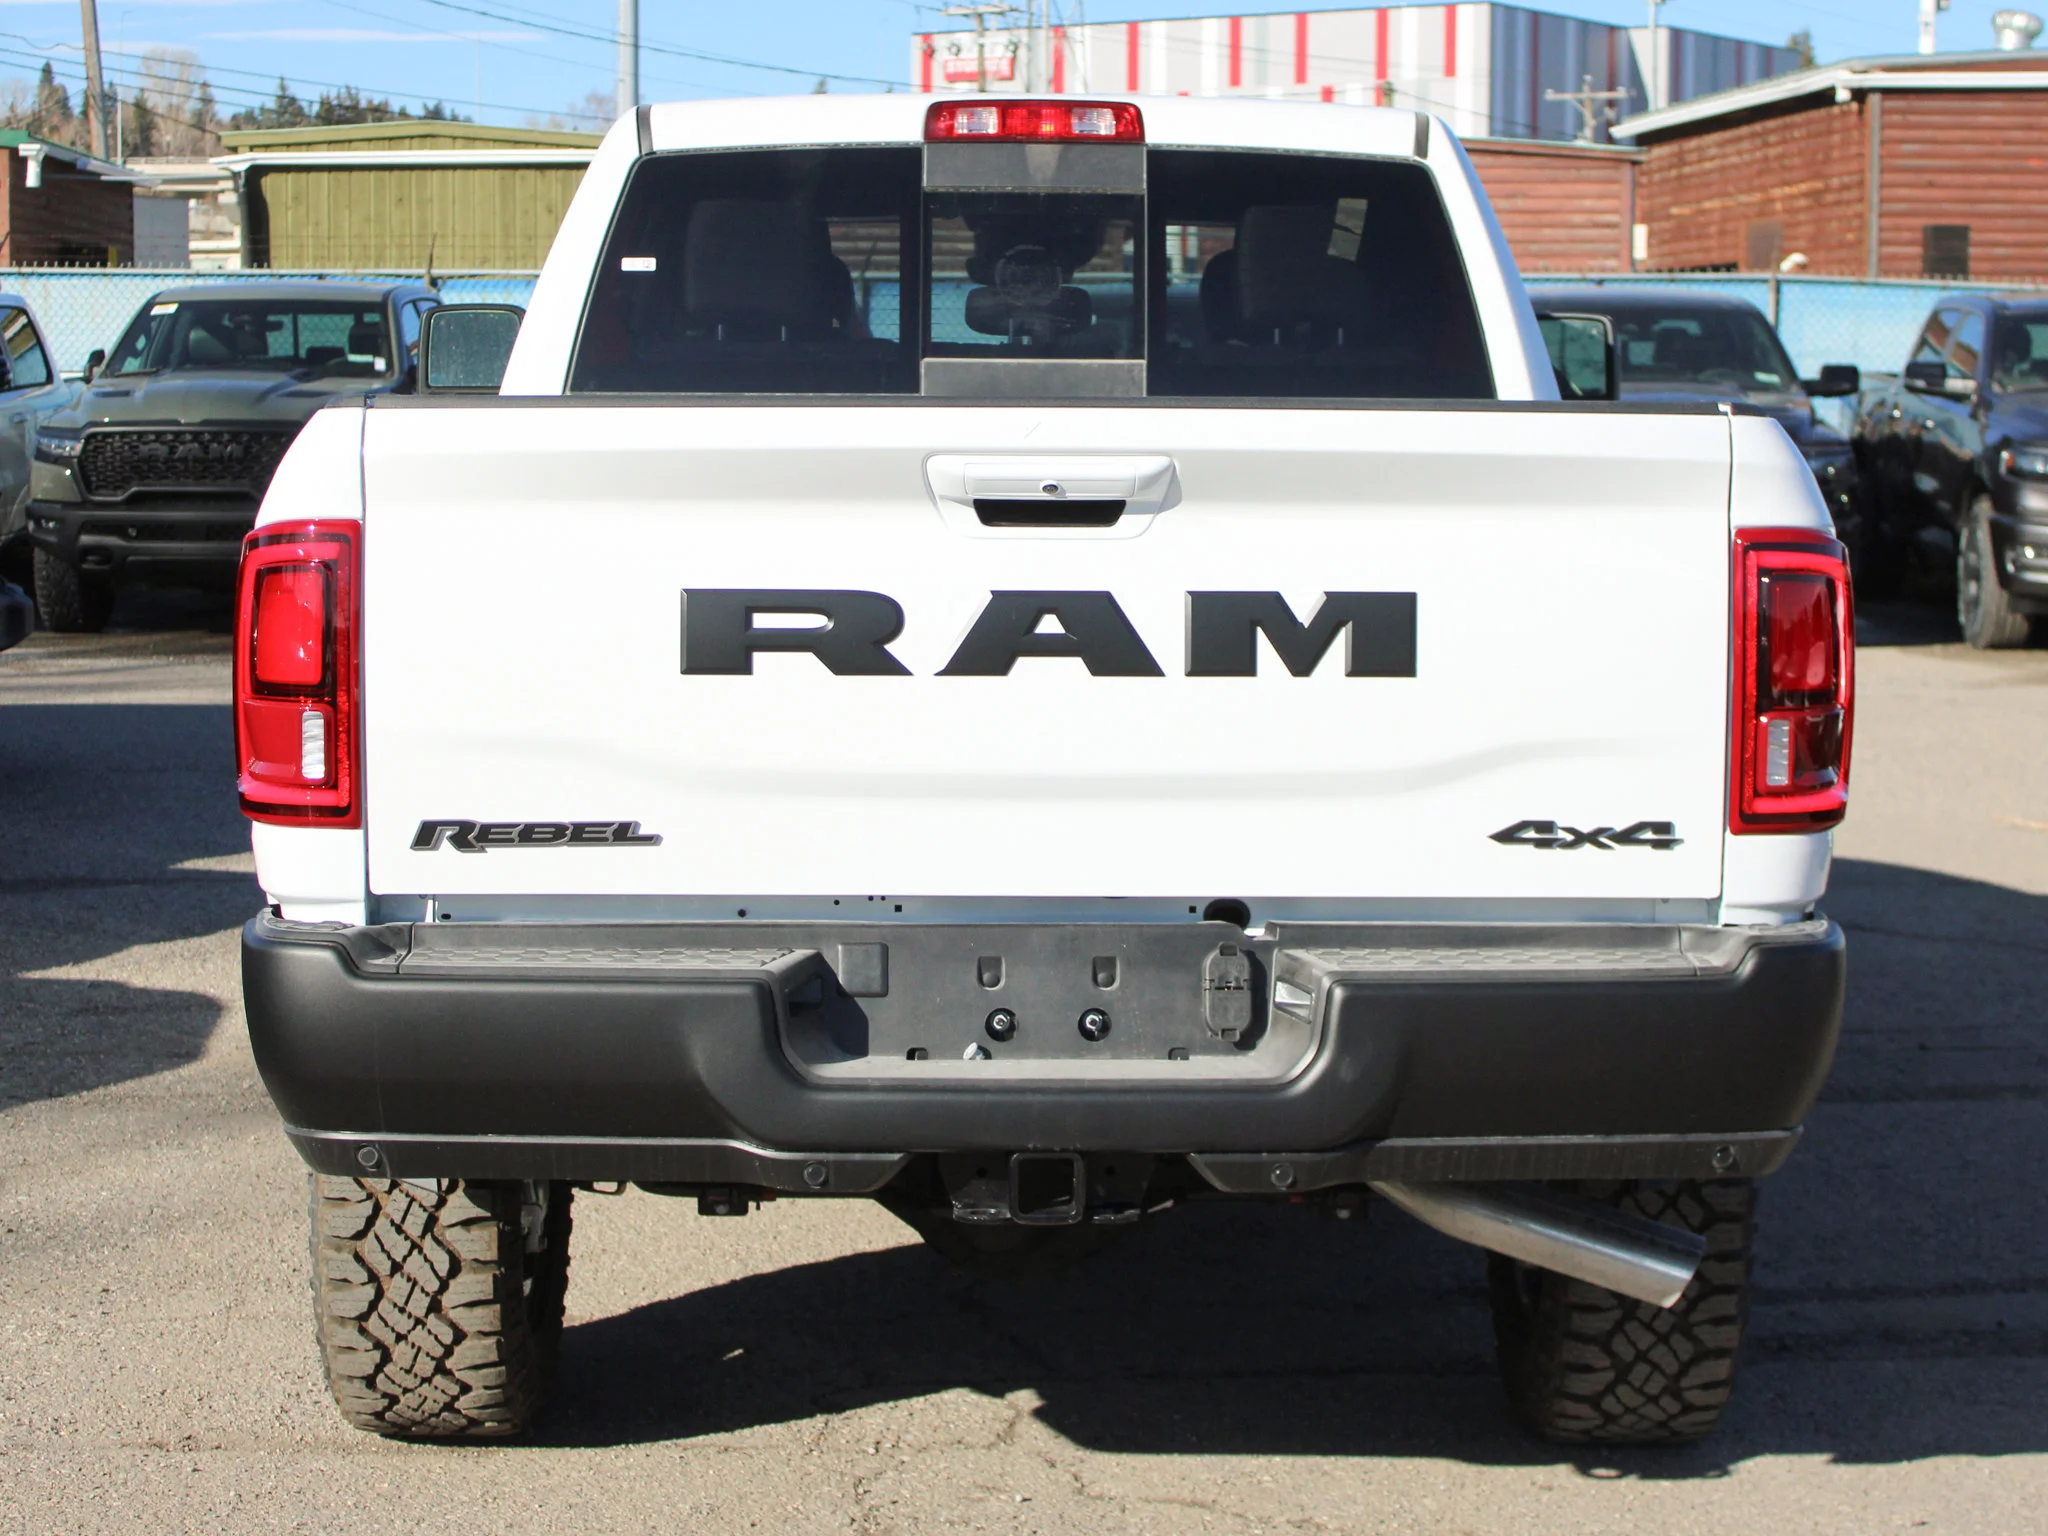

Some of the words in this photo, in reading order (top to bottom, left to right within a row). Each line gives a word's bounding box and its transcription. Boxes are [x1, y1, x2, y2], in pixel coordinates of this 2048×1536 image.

[138, 443, 245, 461] RAM
[680, 588, 1417, 677] RAM
[409, 819, 663, 853] REBEL
